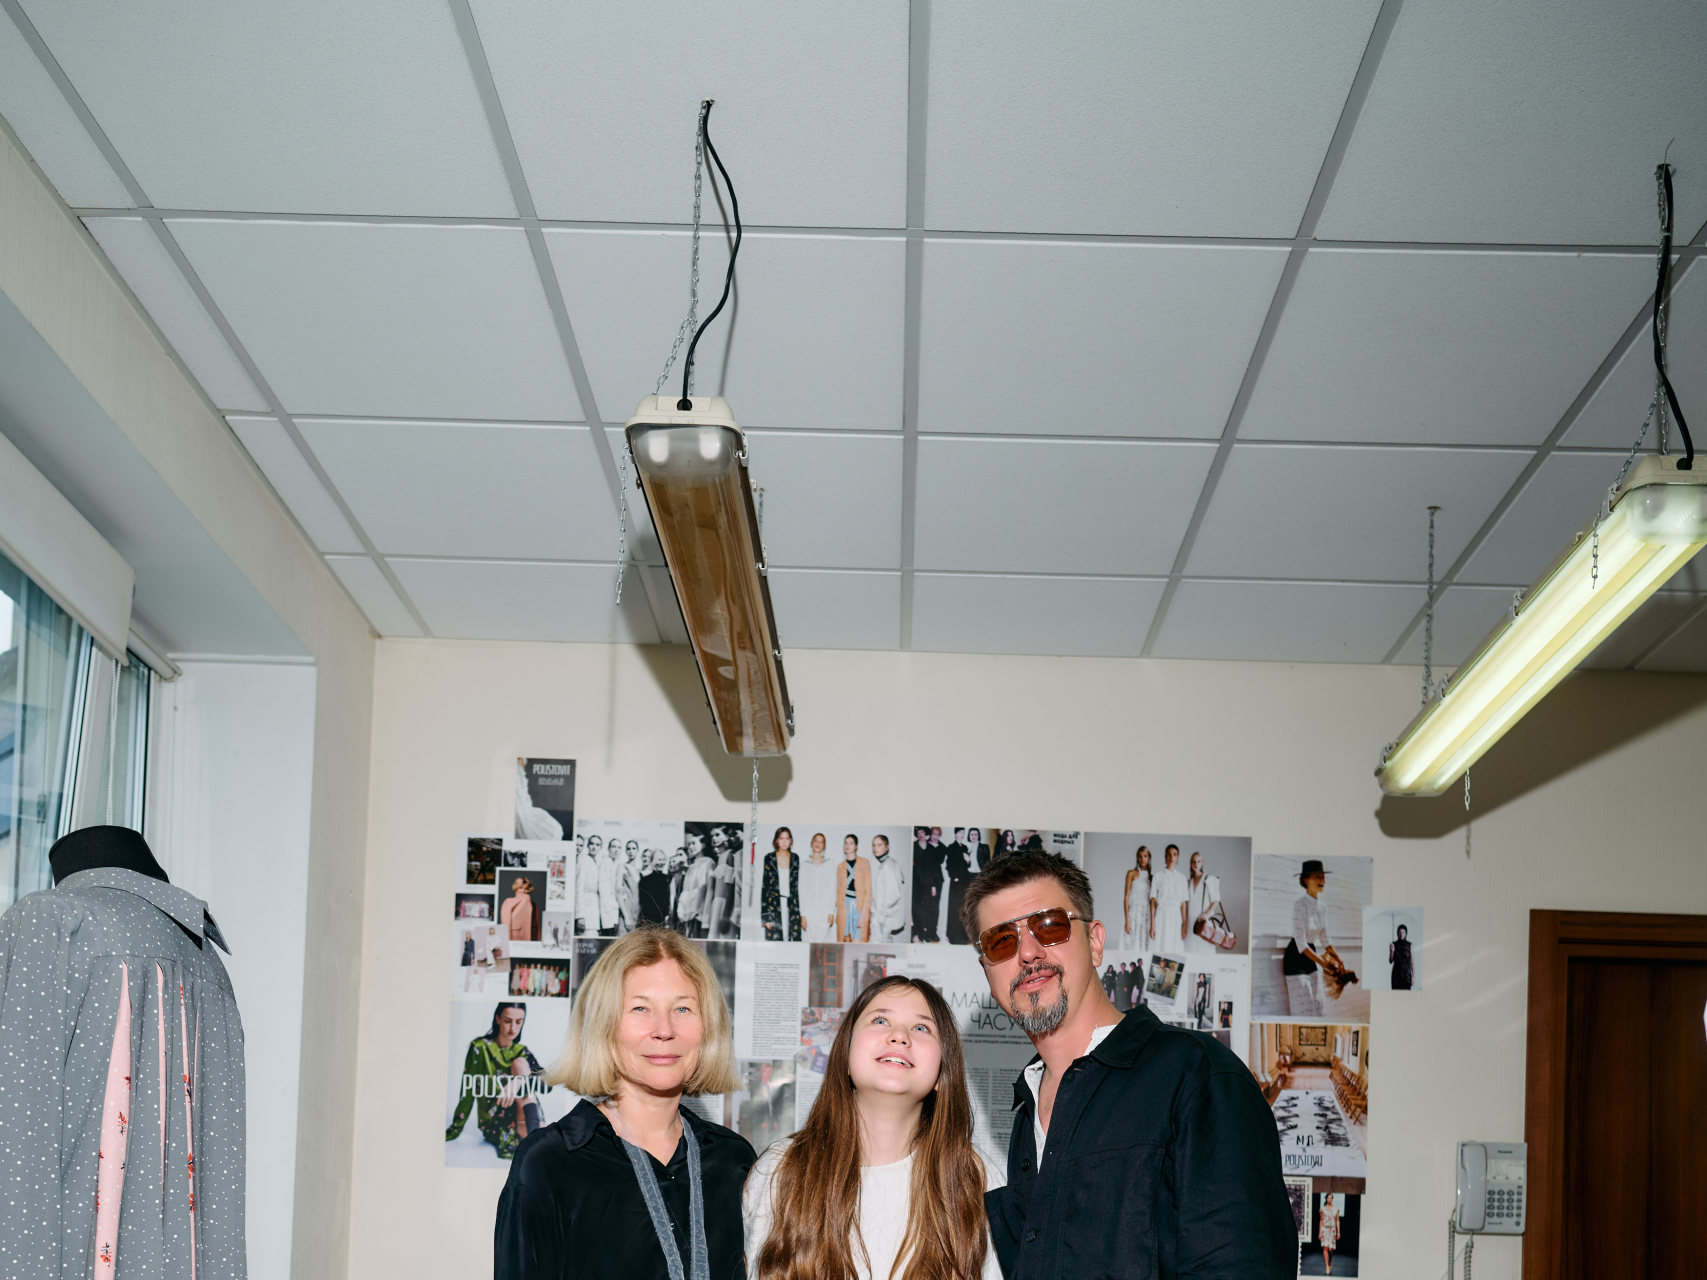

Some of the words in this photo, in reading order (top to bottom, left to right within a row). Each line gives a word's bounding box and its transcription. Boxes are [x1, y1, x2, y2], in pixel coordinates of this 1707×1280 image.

[533, 764, 571, 776] POUSTOVIT
[951, 991, 999, 1010] МАШ
[970, 1012, 1017, 1031] ЧАСУ
